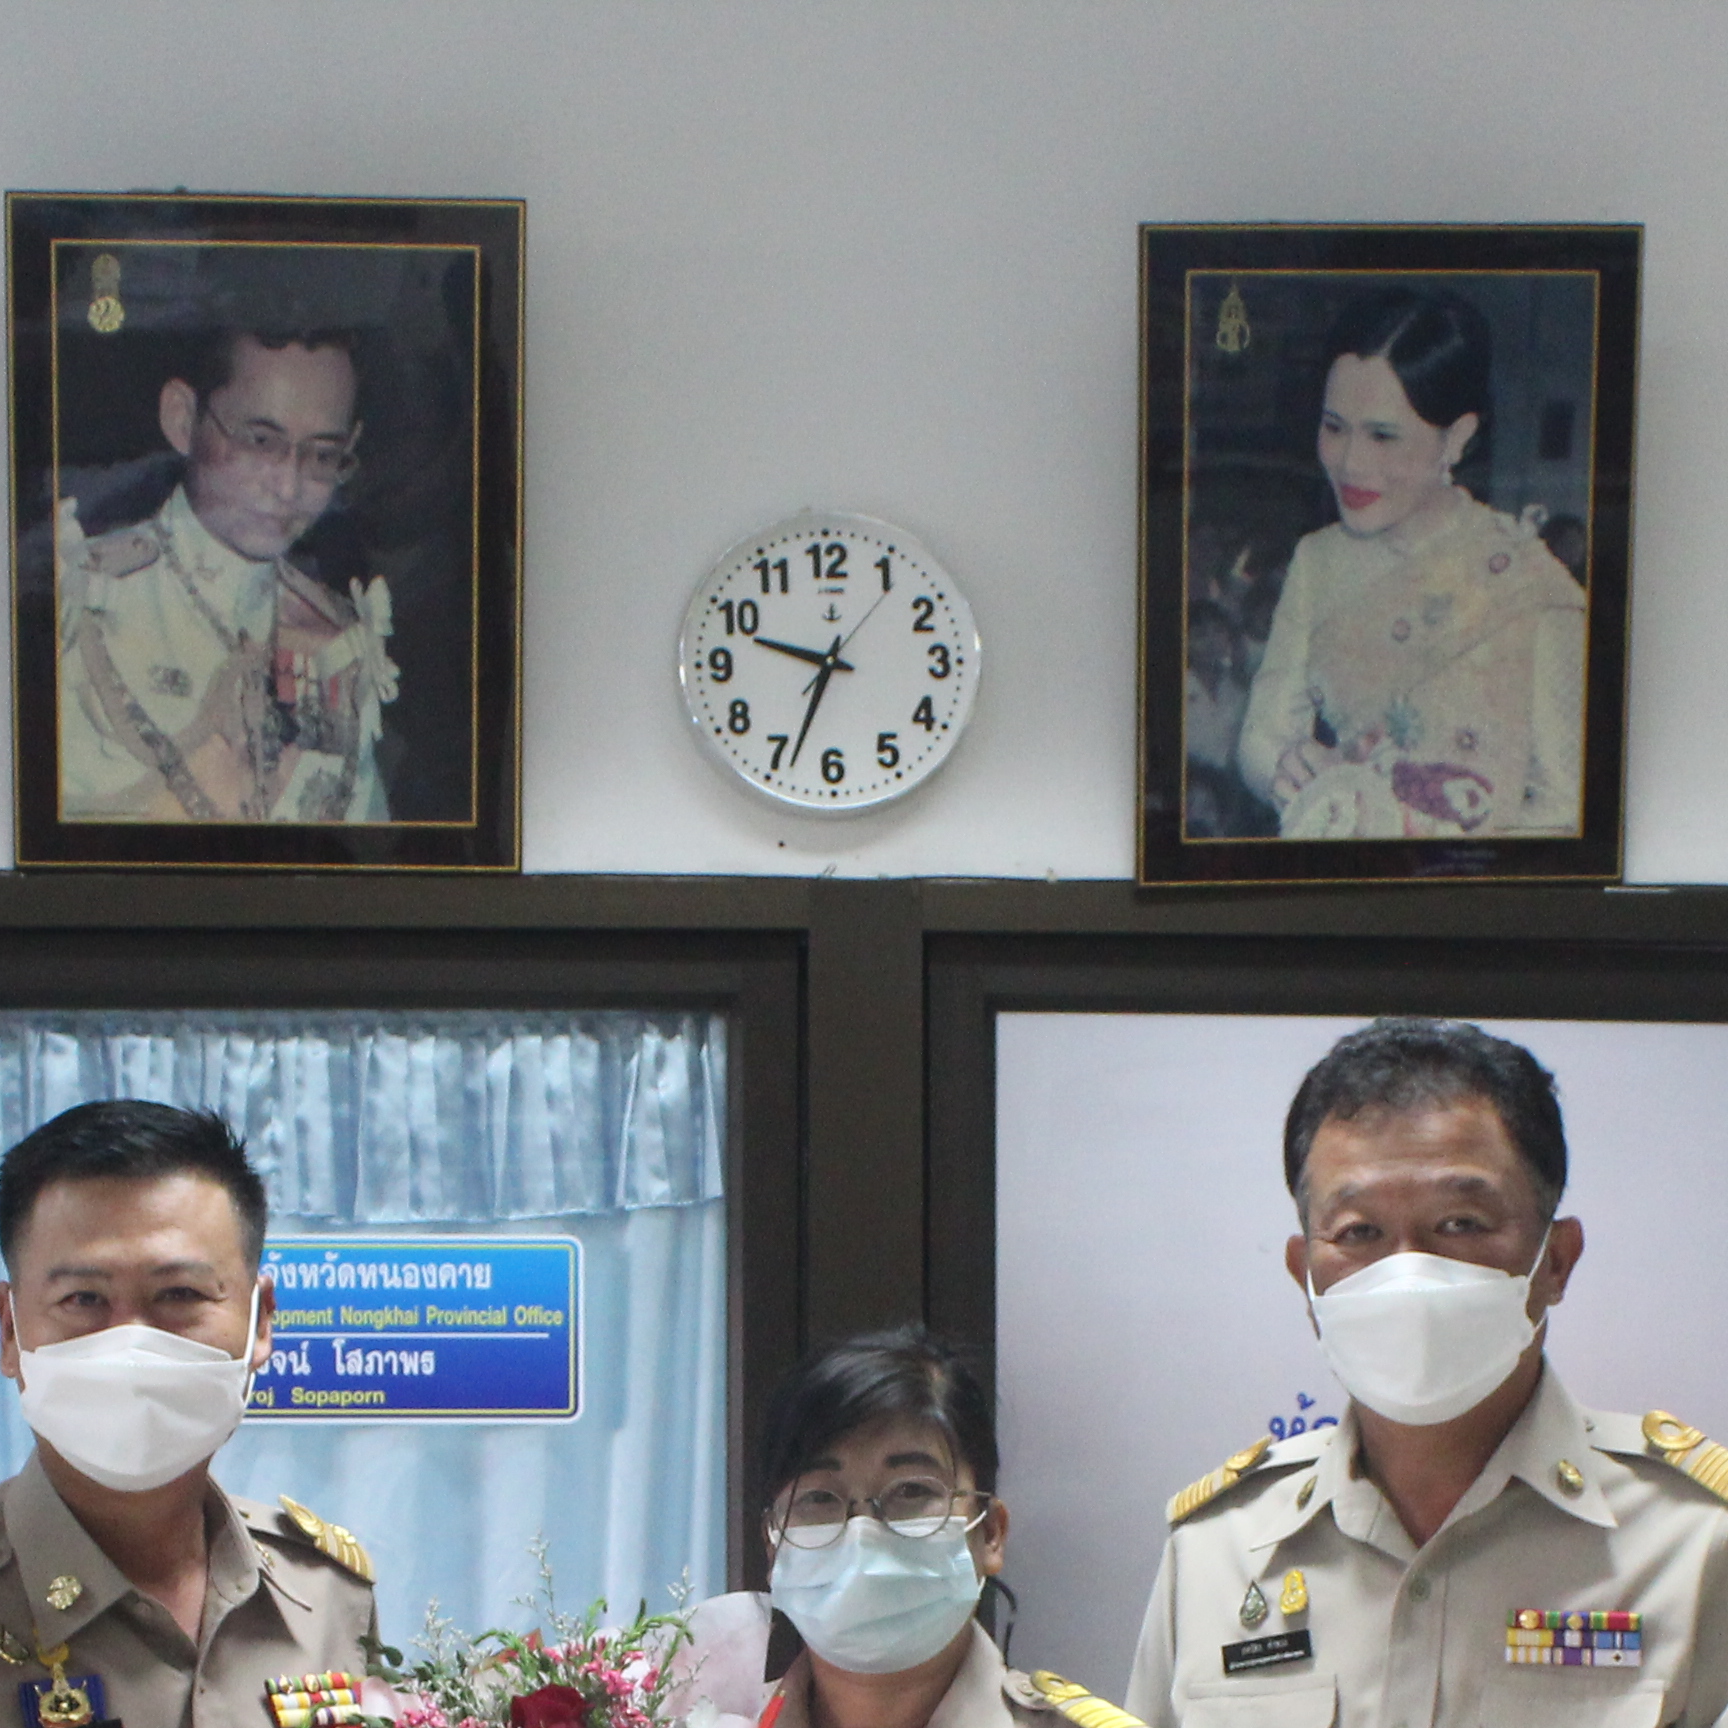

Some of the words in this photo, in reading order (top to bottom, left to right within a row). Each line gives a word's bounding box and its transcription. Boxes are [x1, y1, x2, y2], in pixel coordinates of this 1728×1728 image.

[753, 557, 790, 594] 11
[874, 555, 891, 593] 1
[805, 541, 849, 579] 12
[718, 598, 760, 636] 10
[911, 596, 935, 632] 2
[708, 647, 734, 683] 9
[927, 642, 951, 679] 3
[728, 698, 751, 735] 8
[911, 694, 936, 732] 4
[767, 734, 790, 771] 7
[876, 732, 900, 768] 5
[820, 747, 845, 784] 6
[339, 1304, 419, 1330] Nongkhai
[425, 1304, 508, 1326] Provincial
[514, 1304, 565, 1327] Office
[332, 1338, 436, 1377] โสภาพร
[290, 1386, 386, 1407] Sopaporn
